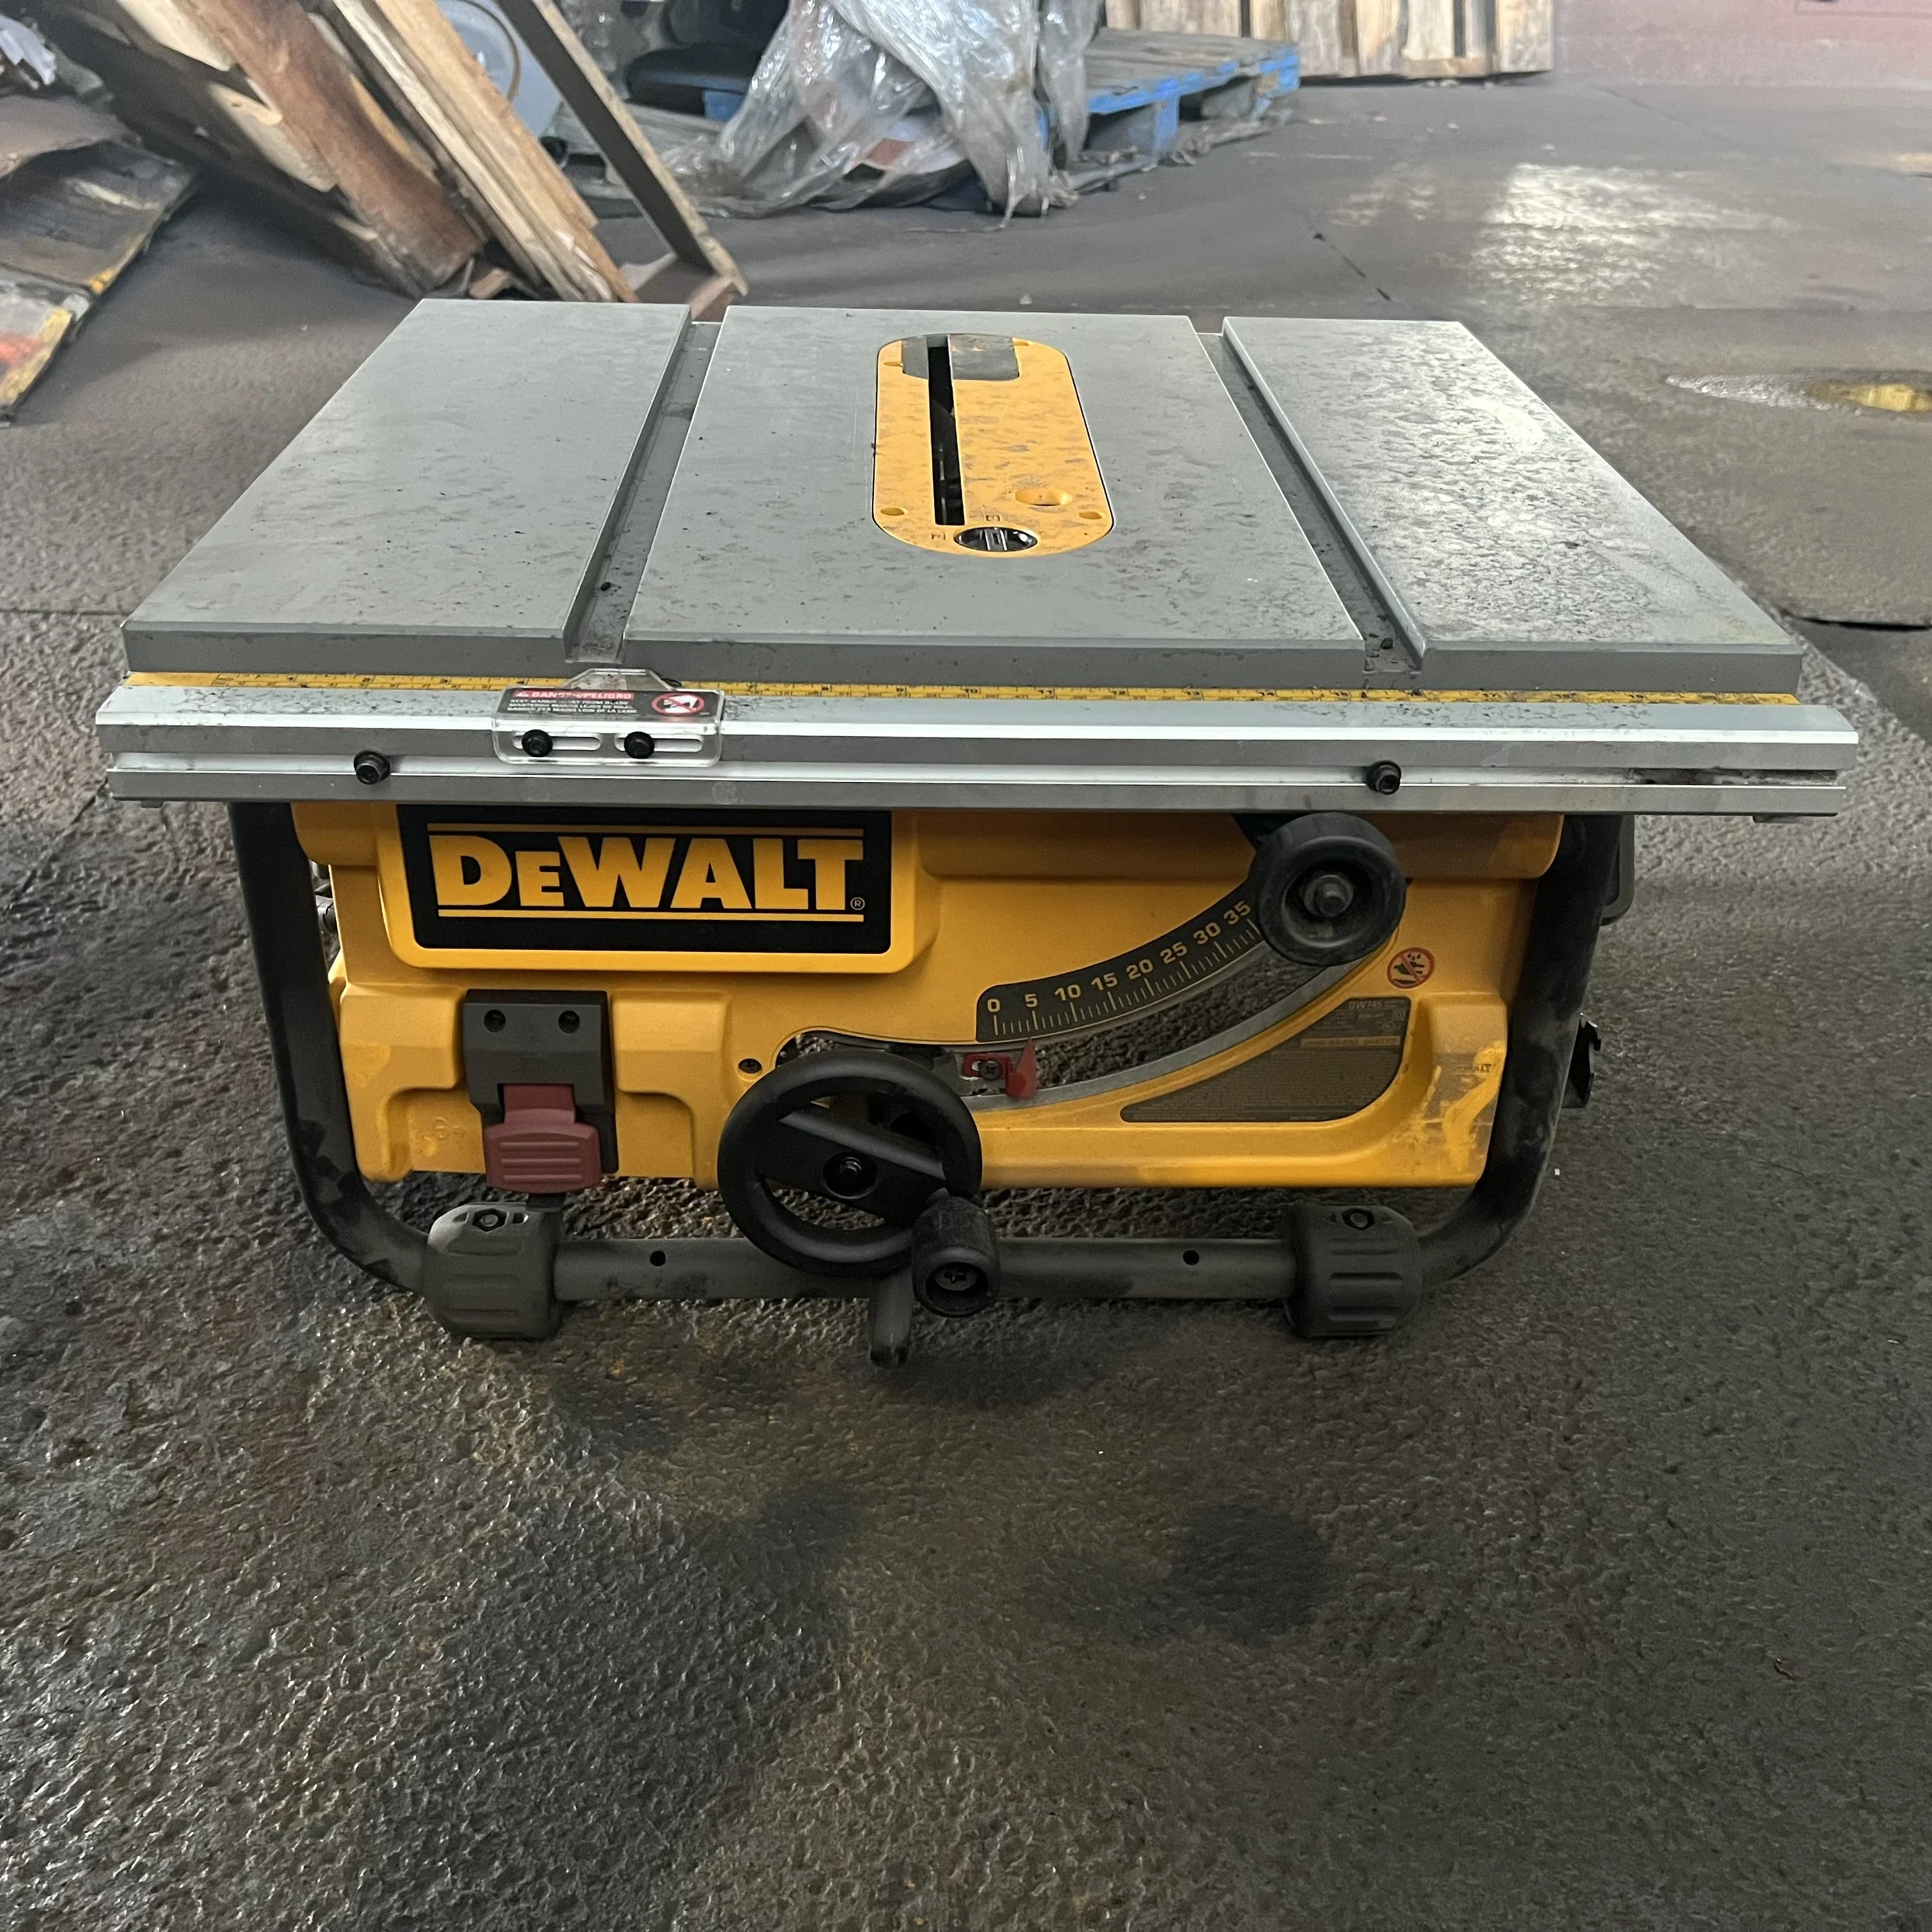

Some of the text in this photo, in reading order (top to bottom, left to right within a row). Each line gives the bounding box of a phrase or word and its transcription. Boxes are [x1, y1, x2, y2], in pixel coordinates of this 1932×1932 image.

[429, 835, 864, 910] DEWALT
[986, 900, 1252, 1013] 0 5 10 15 20 25 30 35
